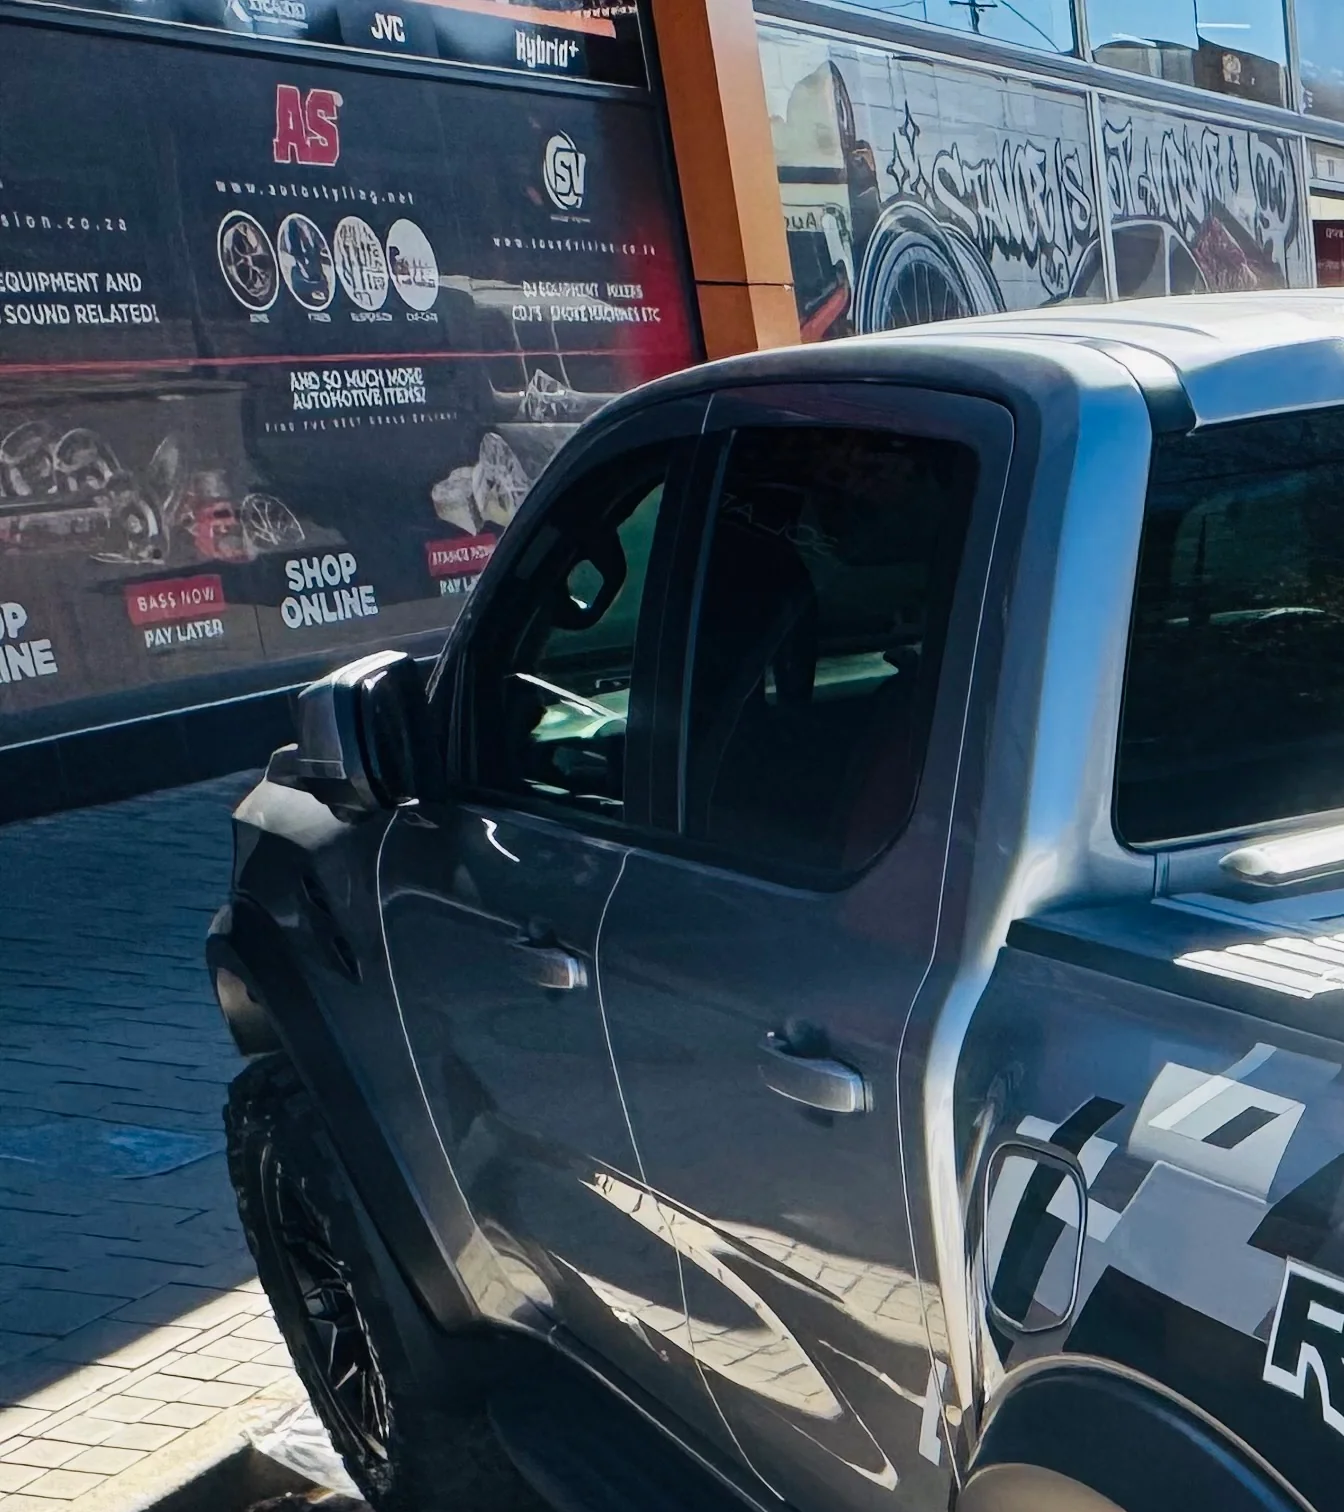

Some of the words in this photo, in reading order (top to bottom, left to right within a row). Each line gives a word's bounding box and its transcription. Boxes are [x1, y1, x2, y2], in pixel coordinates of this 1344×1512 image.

[371, 12, 405, 42] JVC
[273, 84, 345, 166] AS
[106, 272, 142, 293] AND
[4, 304, 70, 325] SOUND
[74, 304, 160, 324] RELATED!
[290, 371, 320, 391] AND
[322, 369, 342, 390] SO
[285, 552, 357, 592] SHOP
[137, 592, 177, 612] BASS
[181, 586, 215, 605] NOW
[280, 584, 379, 629] ONLINE
[144, 627, 173, 648] PAY
[176, 618, 225, 641] LATER
